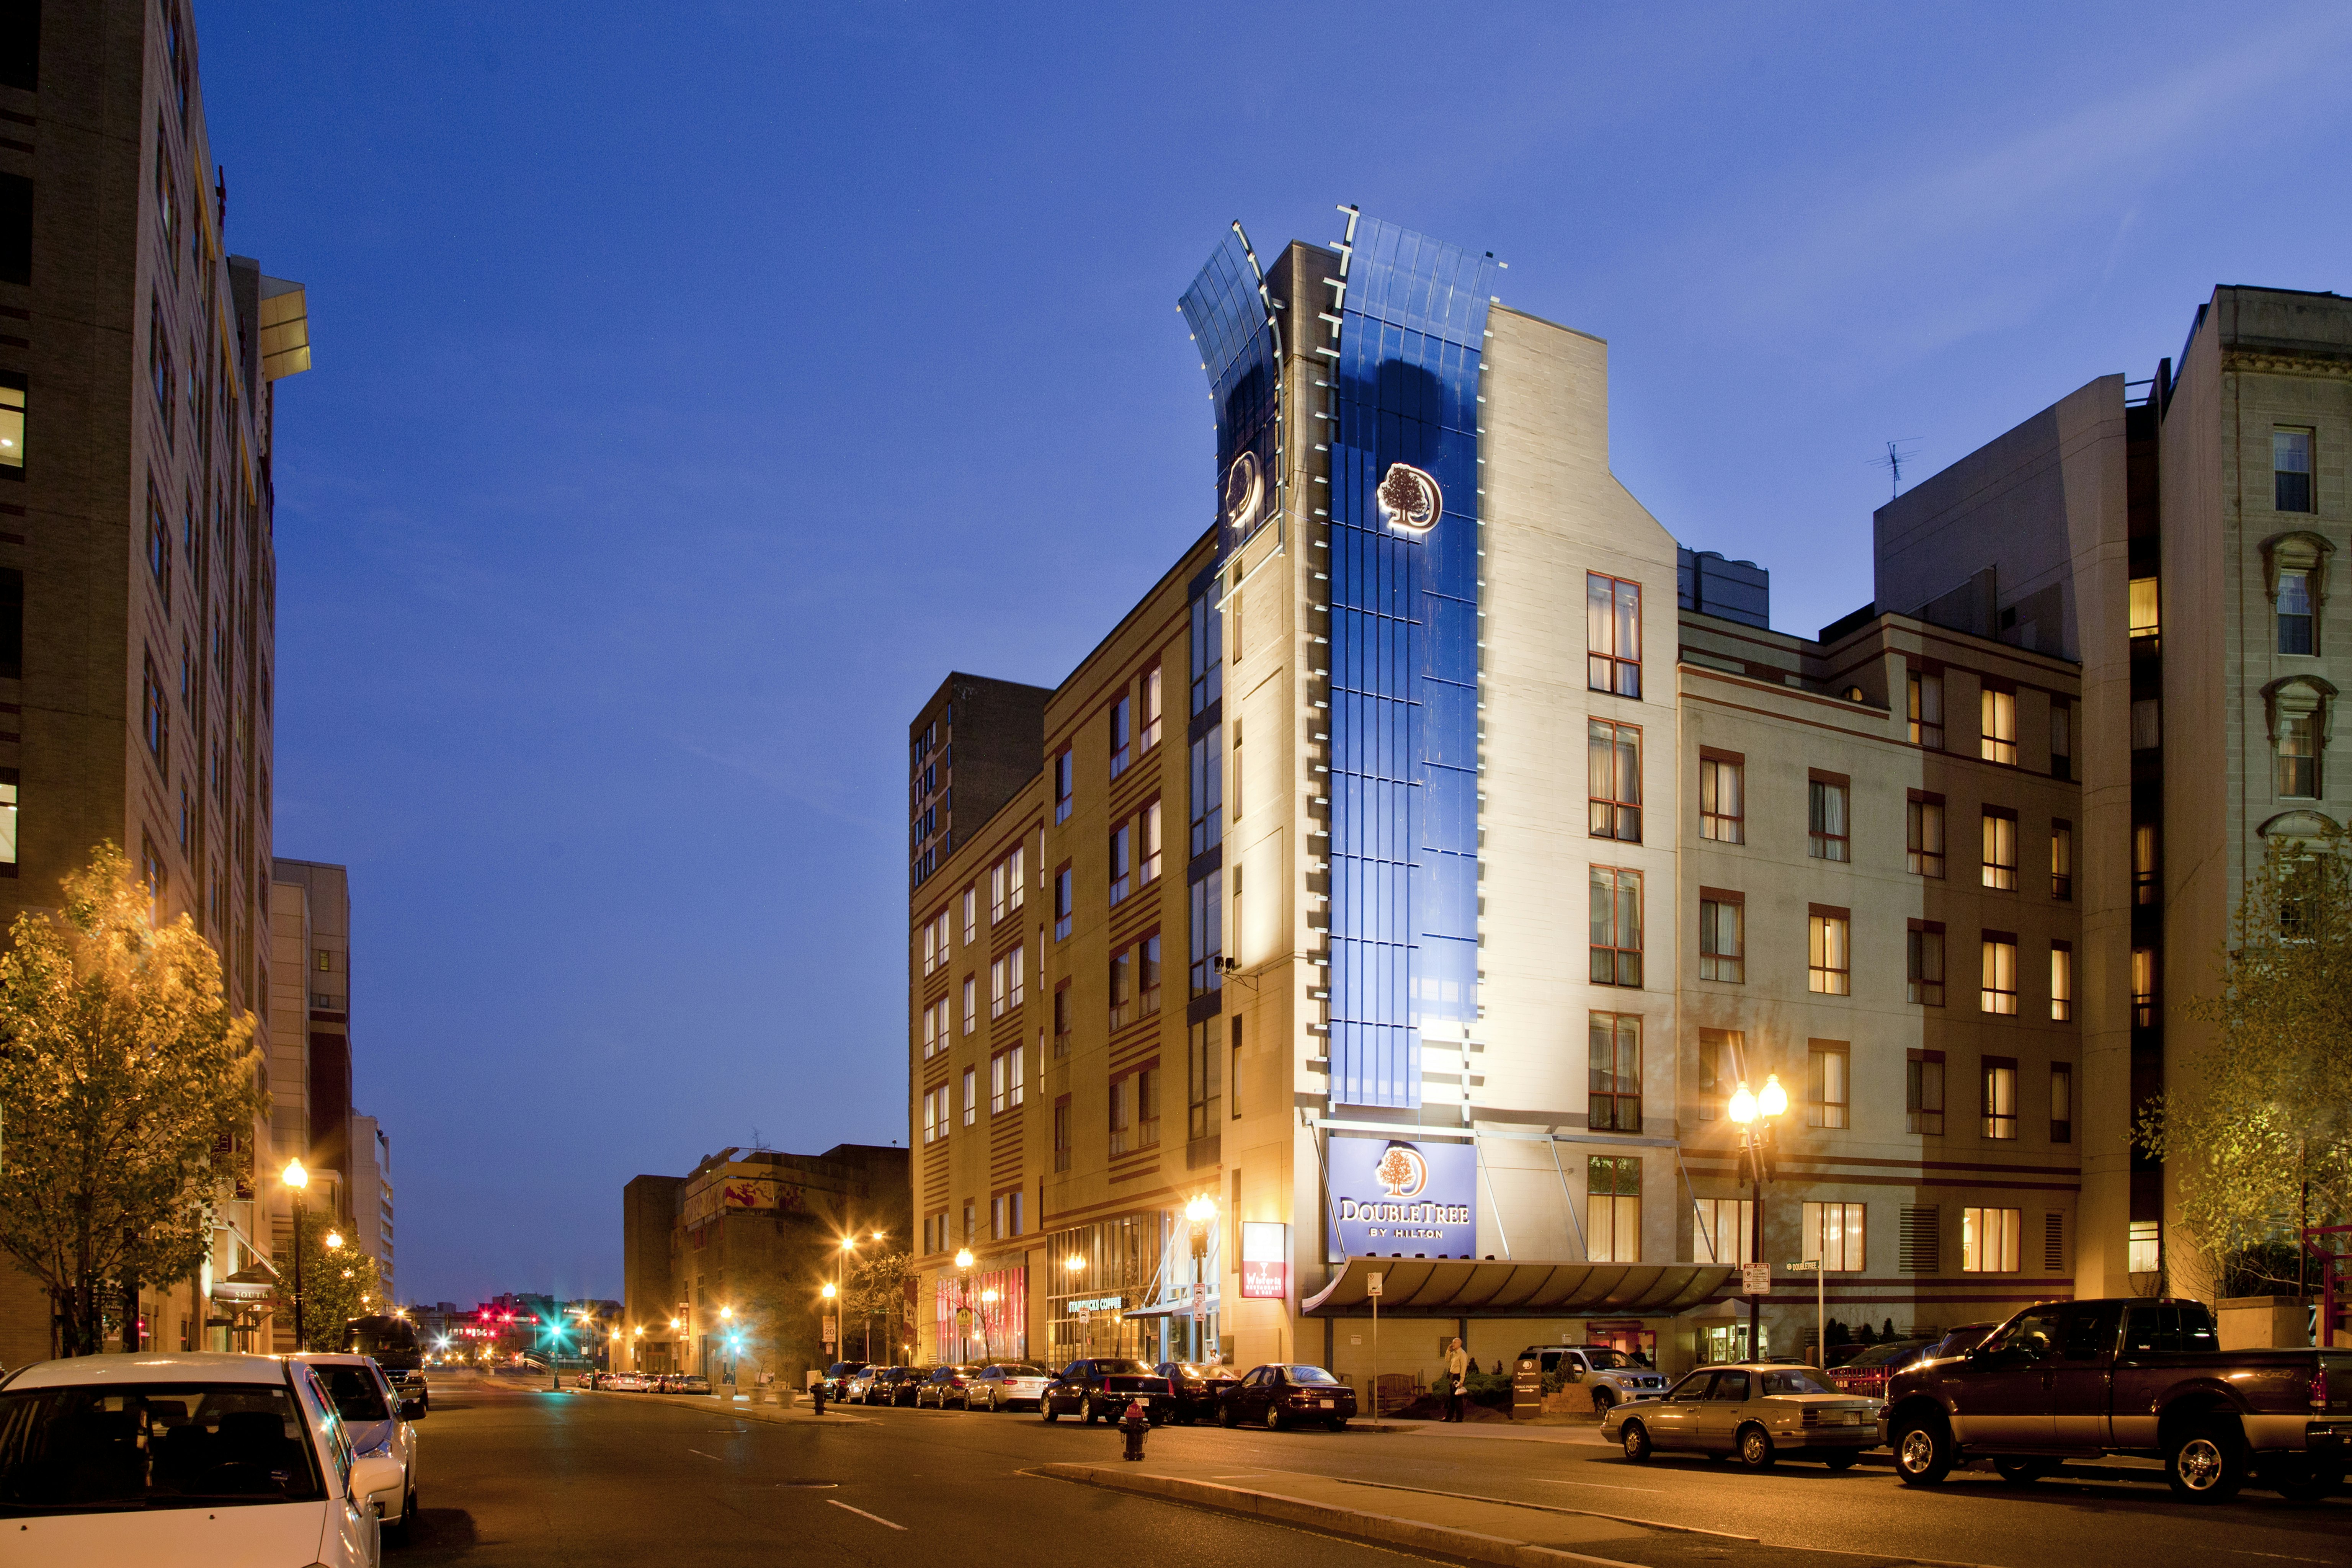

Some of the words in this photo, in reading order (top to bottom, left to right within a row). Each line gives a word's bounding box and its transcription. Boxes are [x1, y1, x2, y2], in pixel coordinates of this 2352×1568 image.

[1370, 1228, 1387, 1237] BY
[1395, 1229, 1443, 1239] HILTON
[1792, 1261, 1817, 1271] DOUBLETREE
[1100, 1297, 1122, 1310] COFFEE
